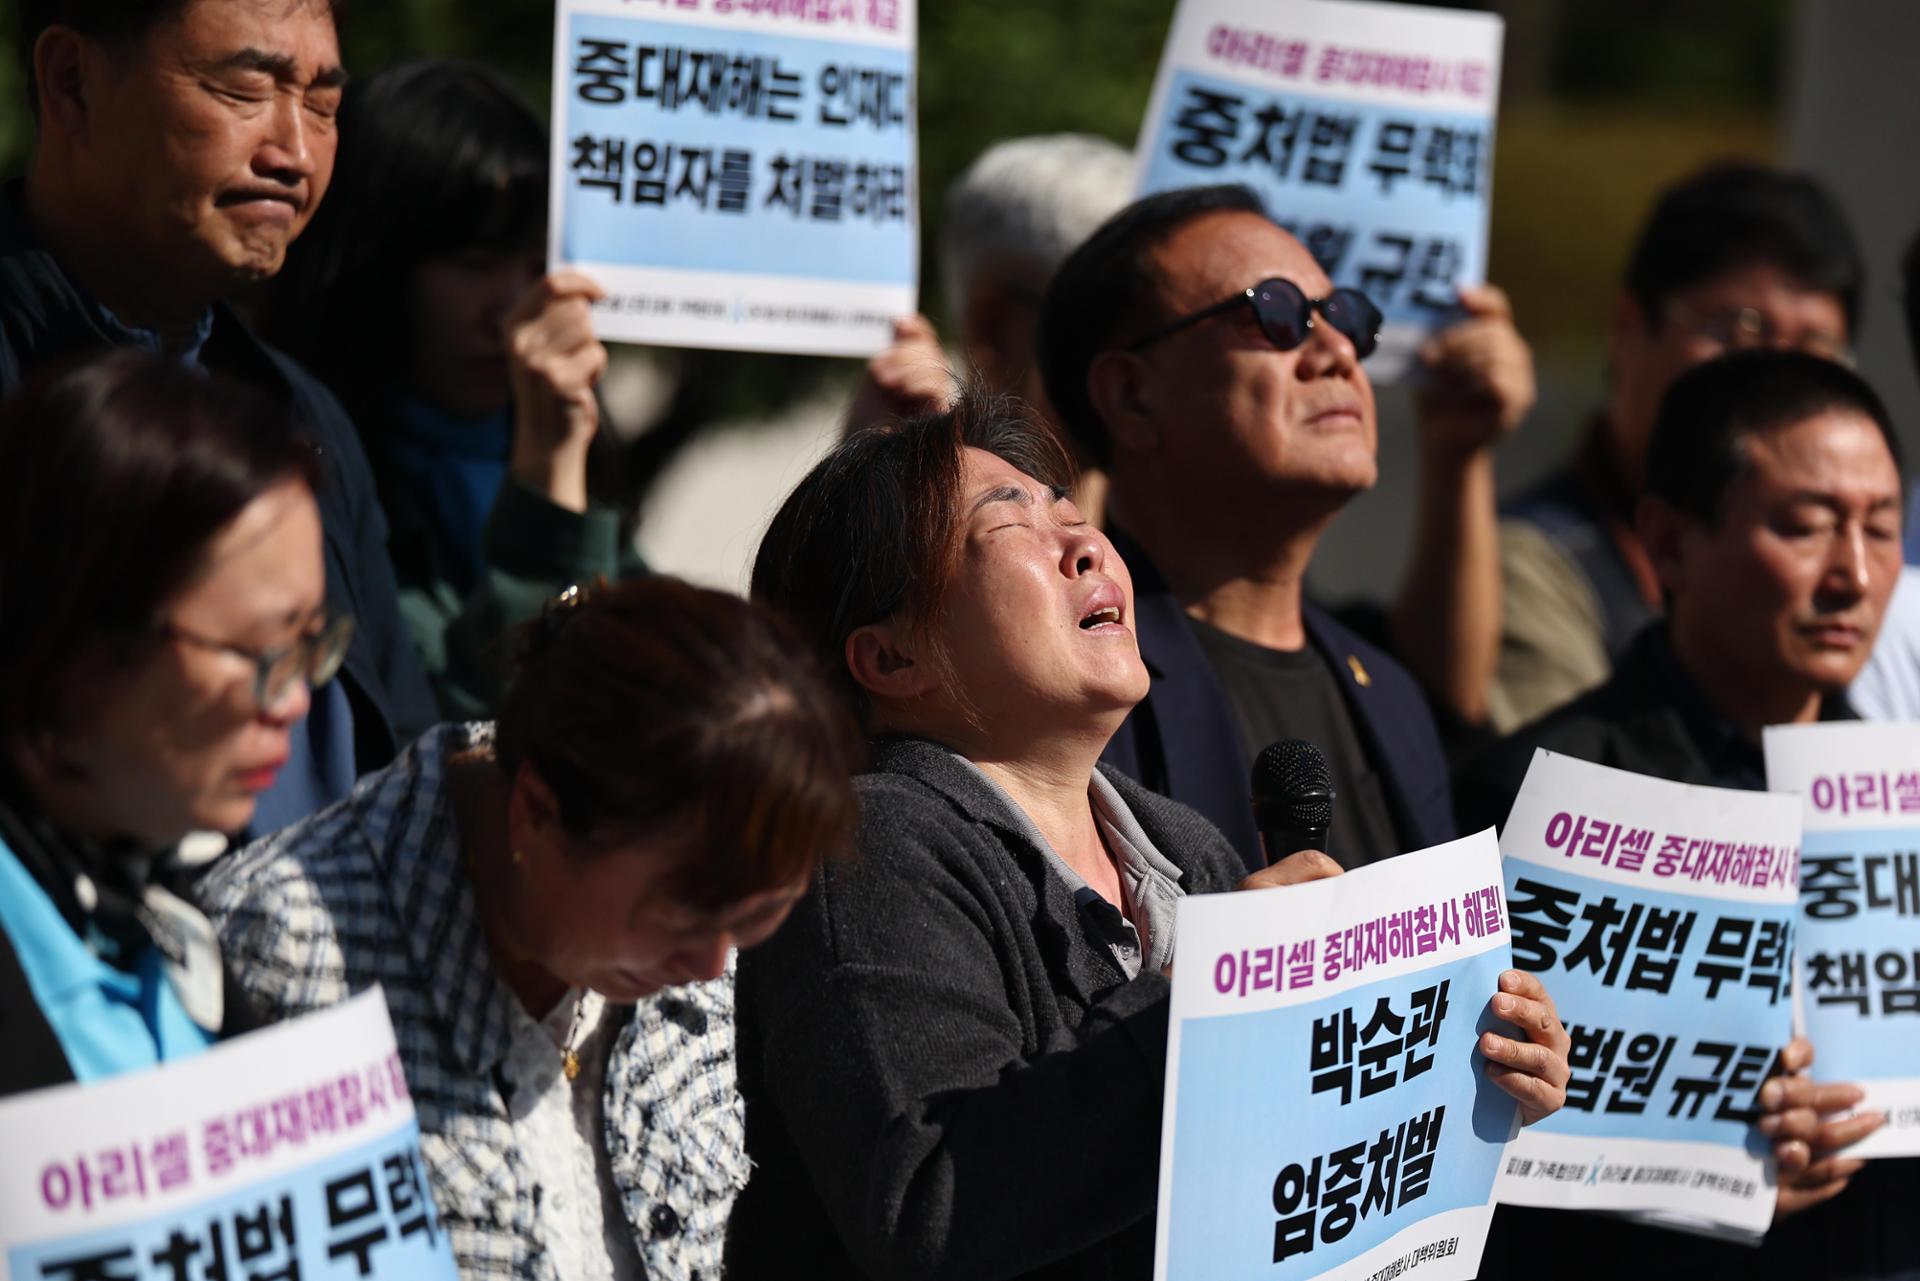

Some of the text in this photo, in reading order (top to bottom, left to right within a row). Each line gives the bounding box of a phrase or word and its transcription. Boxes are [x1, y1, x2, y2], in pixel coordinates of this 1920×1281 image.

[574, 36, 804, 121] 중대재해는
[570, 134, 754, 214] 책임자를
[1169, 84, 1359, 186] 중처법
[1544, 811, 1655, 872] 아리셀
[1214, 885, 1505, 997] 아리셀 중대재해참사 해결!
[1507, 876, 1797, 1007] 중처법 무력
[1309, 979, 1451, 1107] 박순관
[1561, 1020, 1680, 1116] 법원
[40, 1130, 190, 1212] 아리셀
[1271, 1105, 1447, 1264] 엄중처벌
[1411, 1236, 1459, 1268] 대책위원회
